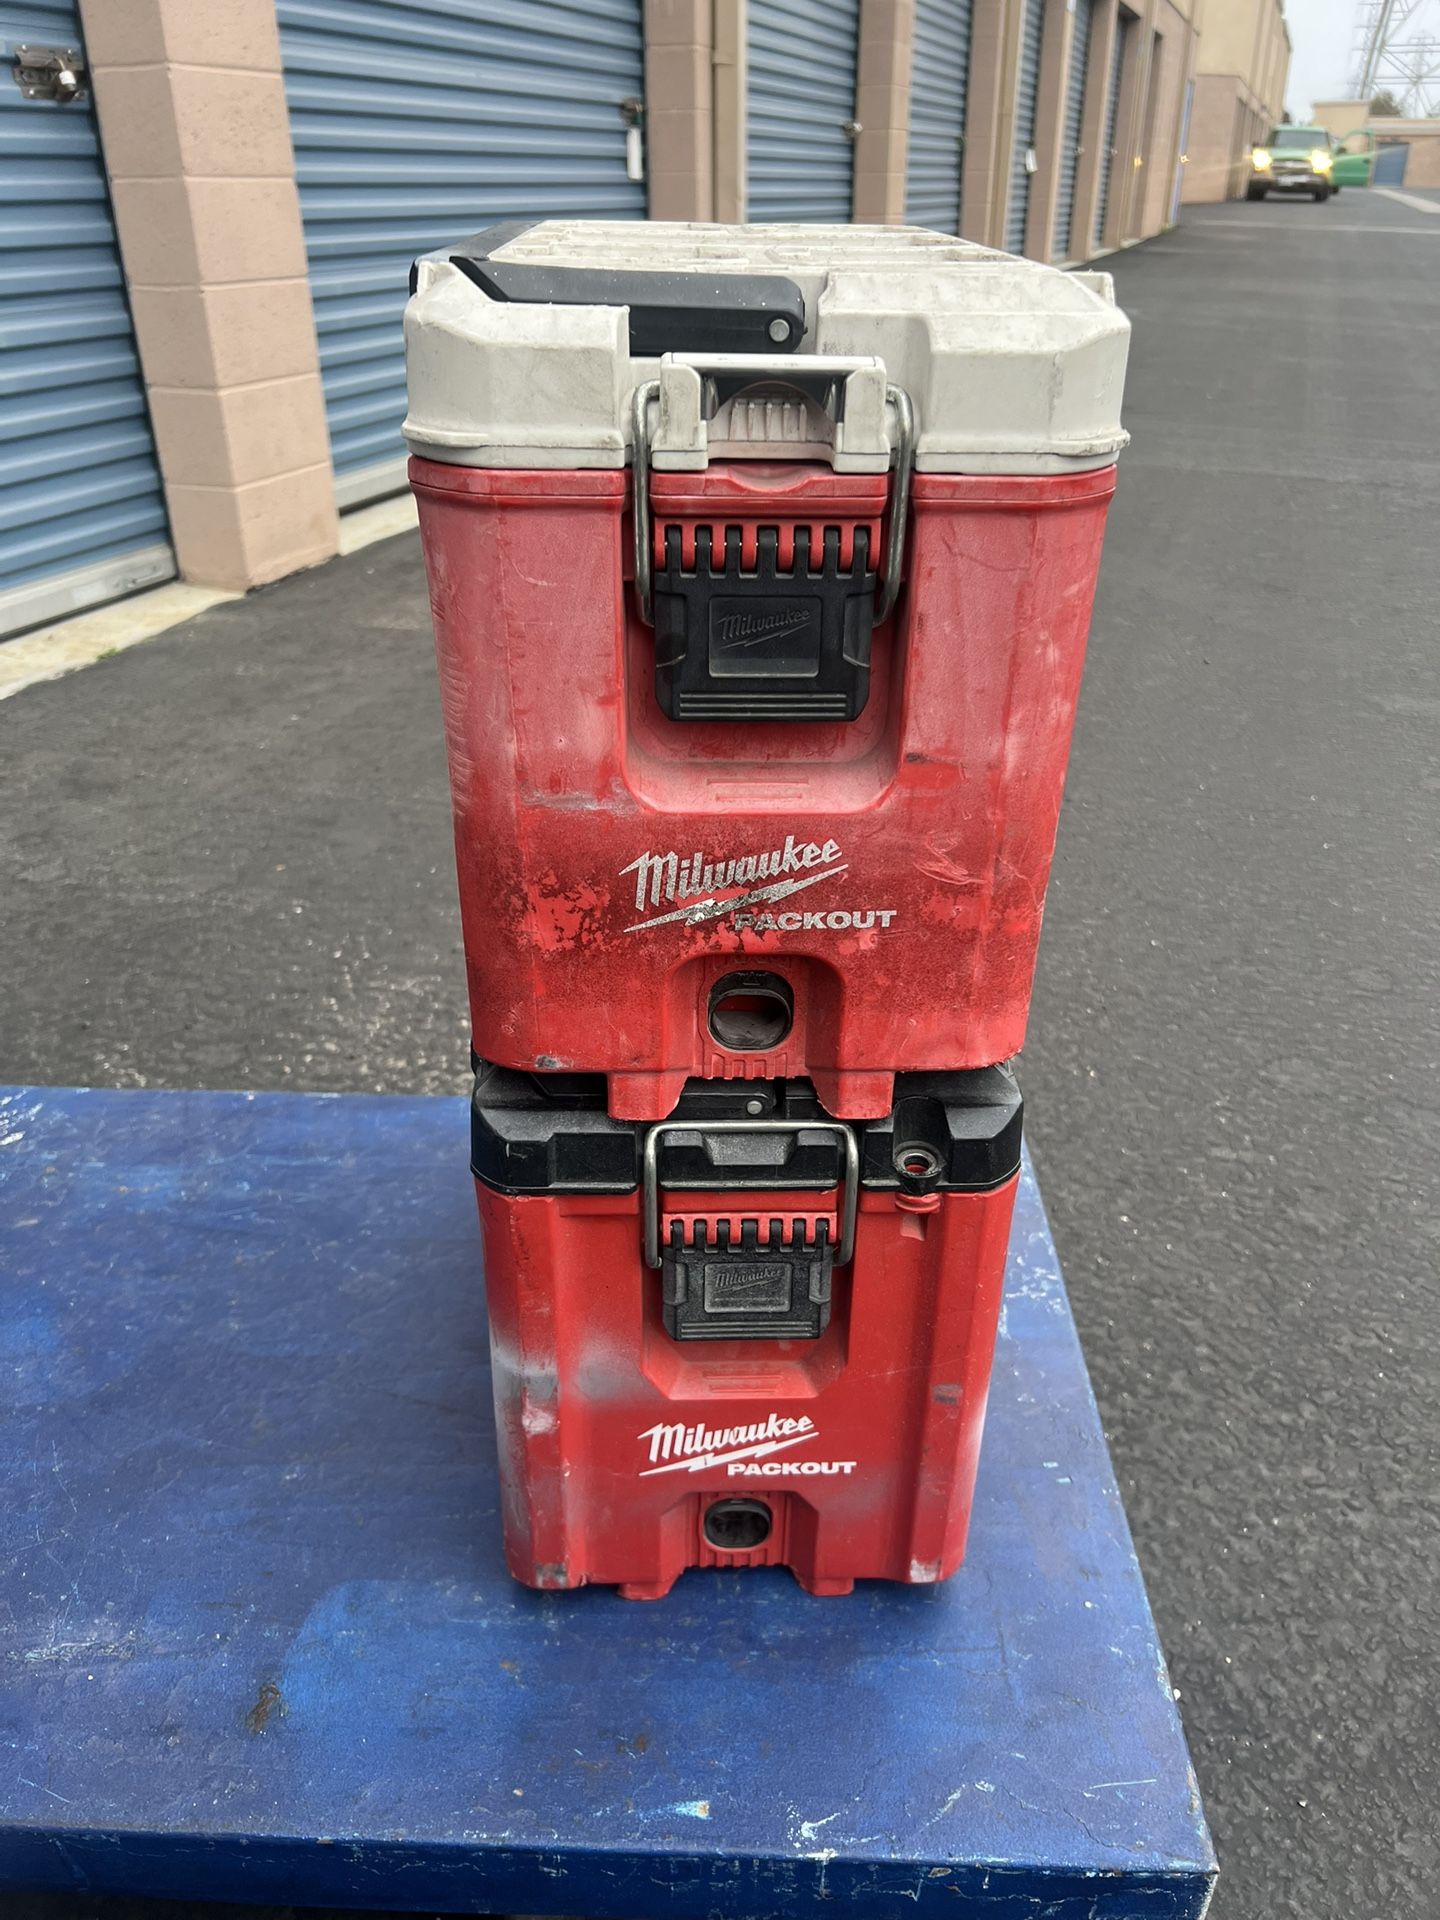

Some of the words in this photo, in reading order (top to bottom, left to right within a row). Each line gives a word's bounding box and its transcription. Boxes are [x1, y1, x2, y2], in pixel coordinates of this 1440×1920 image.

[717, 610, 810, 640] Milwaukee
[619, 835, 842, 912] Milwaukee
[735, 910, 897, 931] PACKOUT
[714, 1268, 782, 1288] Milwaukee
[637, 1413, 815, 1463] Milwaukee
[727, 1461, 857, 1476] PACKOUT
